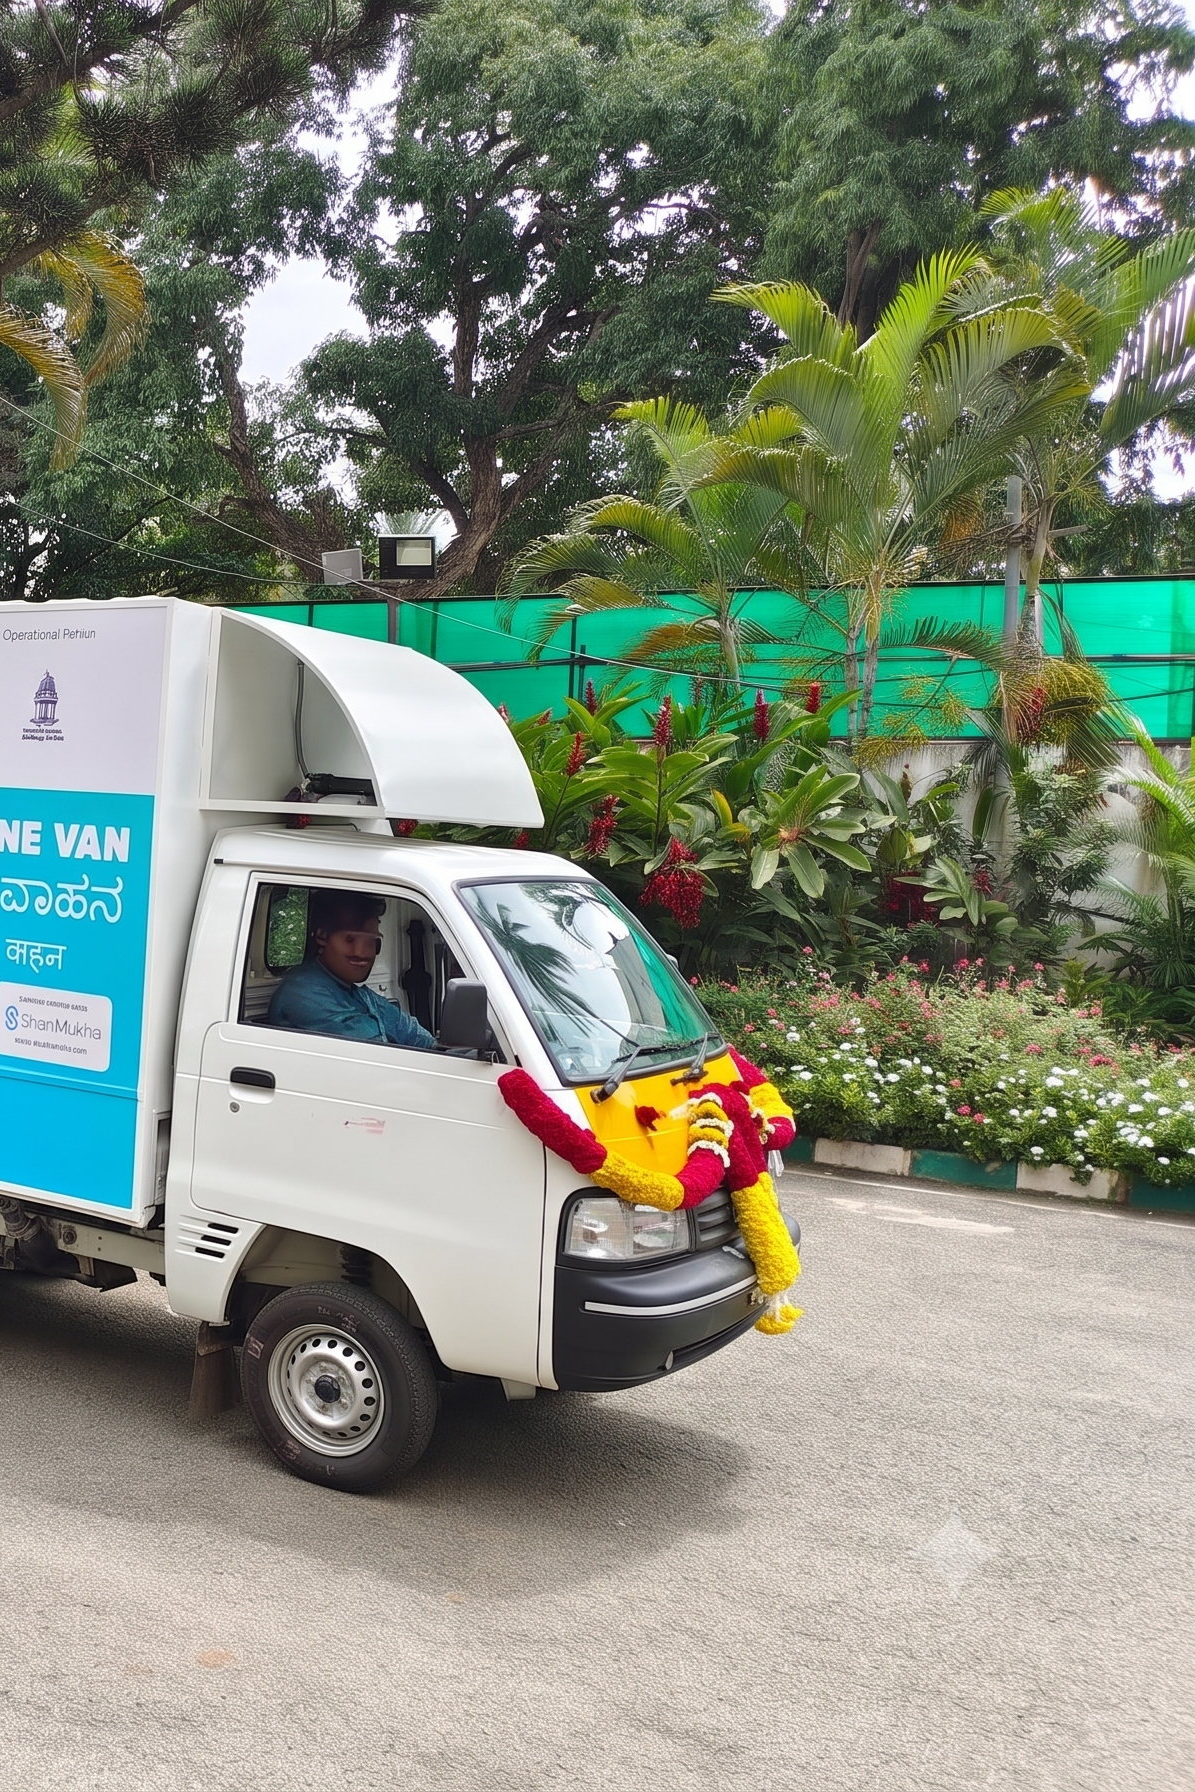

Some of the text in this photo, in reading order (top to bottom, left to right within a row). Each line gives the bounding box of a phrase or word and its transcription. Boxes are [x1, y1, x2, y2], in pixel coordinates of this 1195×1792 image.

[2, 628, 61, 643] Operational
[53, 822, 131, 863] VAN
[0, 873, 124, 924] ವಾಹನ
[20, 1013, 103, 1041] ShanMukha
